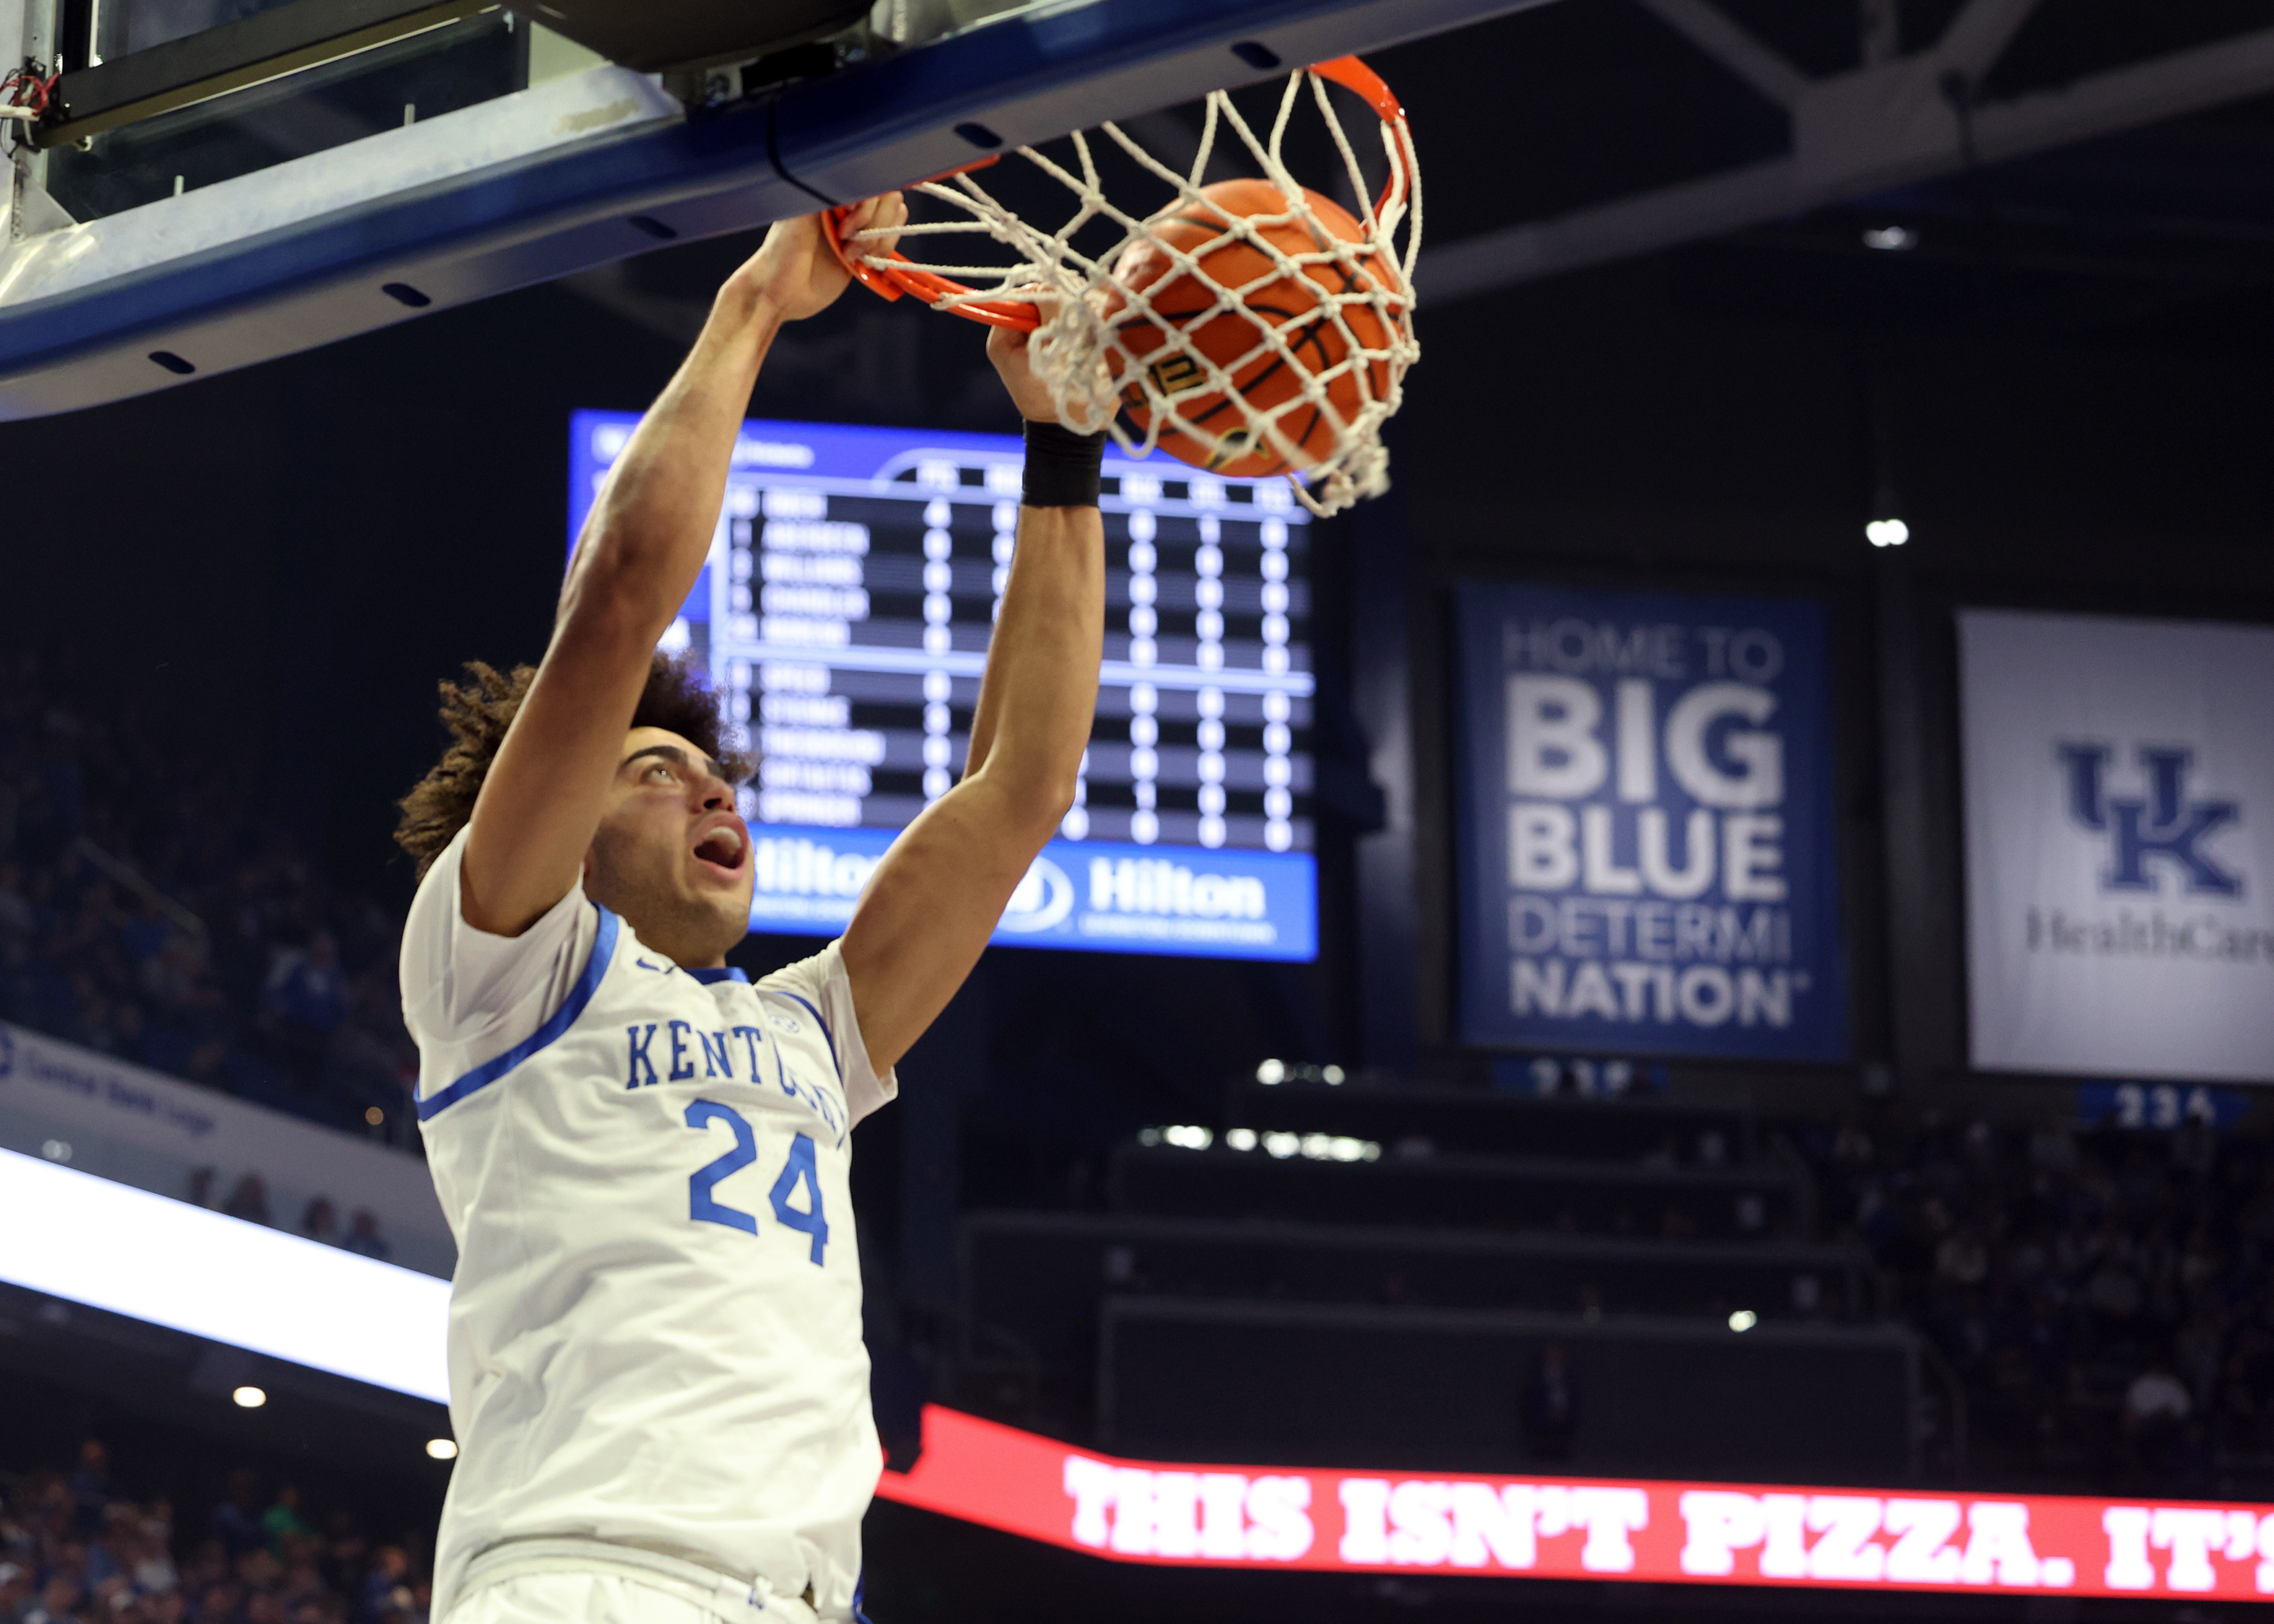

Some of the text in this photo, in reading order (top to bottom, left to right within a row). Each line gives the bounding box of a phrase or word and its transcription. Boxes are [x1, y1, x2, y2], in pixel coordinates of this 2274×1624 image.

[1504, 618, 1785, 682] HOME TO
[1506, 674, 1785, 809] BIG
[1507, 803, 1788, 902] BLUE
[2056, 738, 2244, 902] UK
[1089, 855, 1268, 920] Hilton
[1507, 895, 1792, 962] DETERMI
[1510, 959, 1793, 1028] NATION
[684, 1098, 829, 1268] 24
[1064, 1454, 2274, 1594] THIS ISN'T PIZZA. IT'
